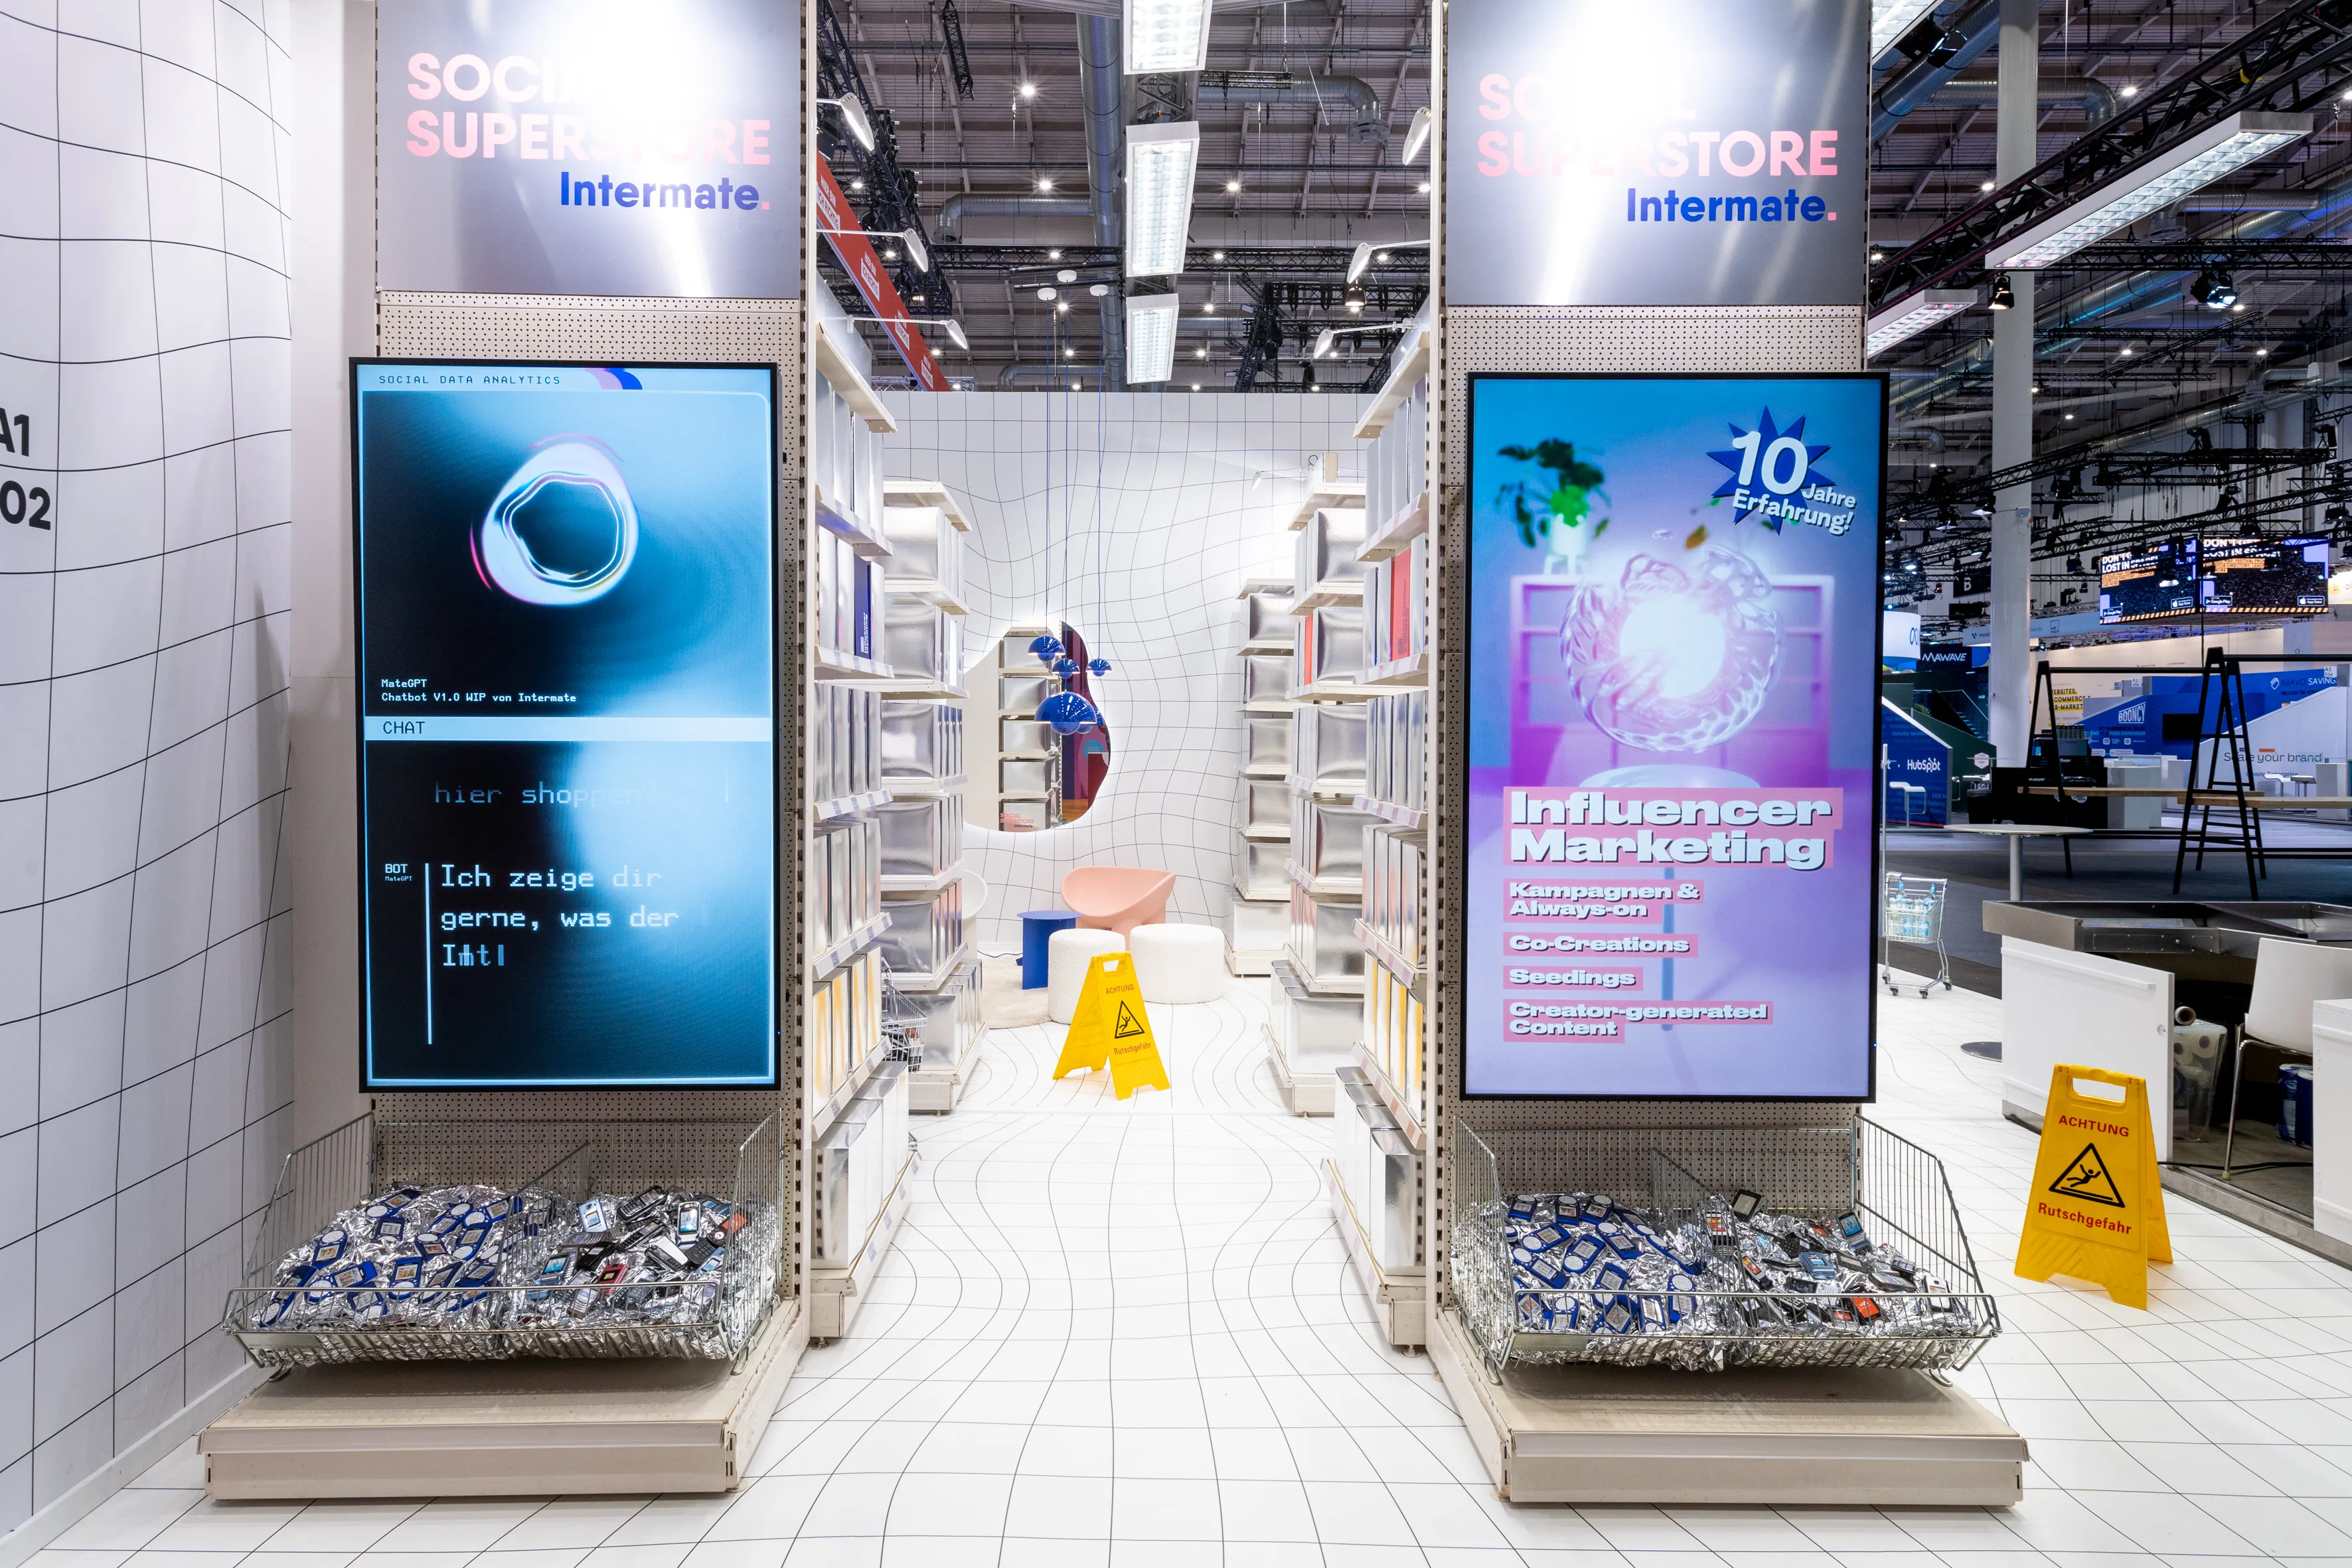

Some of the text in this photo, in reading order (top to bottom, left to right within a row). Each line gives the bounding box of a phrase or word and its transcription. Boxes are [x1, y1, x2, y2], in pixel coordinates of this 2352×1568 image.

[407, 110, 771, 165] SUPERSTORE
[1477, 130, 1838, 177] SUPERSTORE
[561, 172, 770, 210] Intermate.
[1628, 188, 1836, 222] Intermate.
[379, 375, 560, 384] SOCIAL DATA ANALYTICS
[0, 408, 29, 457] A1
[1732, 430, 1808, 495] 10
[1802, 483, 1857, 509] Jahre
[1733, 488, 1855, 536] Erfahrung!
[2102, 552, 2125, 565] DON'T
[2102, 562, 2122, 574] LOST
[2122, 560, 2130, 570] IN
[1922, 652, 1968, 663] MAWAVE
[381, 679, 428, 688] MateGPT
[382, 692, 428, 702] Chatbot
[433, 692, 460, 702] V1.0
[466, 692, 486, 702] WIP
[518, 693, 576, 702] Intermate
[2118, 703, 2146, 722] BOONCY
[383, 721, 425, 734] CHAT
[1907, 757, 1941, 773] HubSpot
[2257, 753, 2285, 763] your
[2288, 753, 2321, 762] brand
[435, 781, 502, 803] hier
[1511, 790, 1833, 826] Influencer
[1511, 828, 1826, 871] Marketing
[385, 864, 408, 874] BOT
[441, 864, 662, 891] Ich zeige dir
[1510, 882, 1700, 901] Kampagnen &
[441, 904, 679, 931] gerne, was der
[1510, 901, 1648, 919] Always-on
[1510, 935, 1690, 953] Co-Creations
[1510, 969, 1636, 988] Seedings
[1106, 984, 1135, 994] ACHTUNG
[1510, 1002, 1768, 1022] Creator-generated
[1510, 1019, 1618, 1036] Content
[1113, 1042, 1152, 1055] Rutschgefahr
[2059, 1115, 2130, 1137] ACHTUNG
[2038, 1202, 2132, 1235] Rutschgefahr
